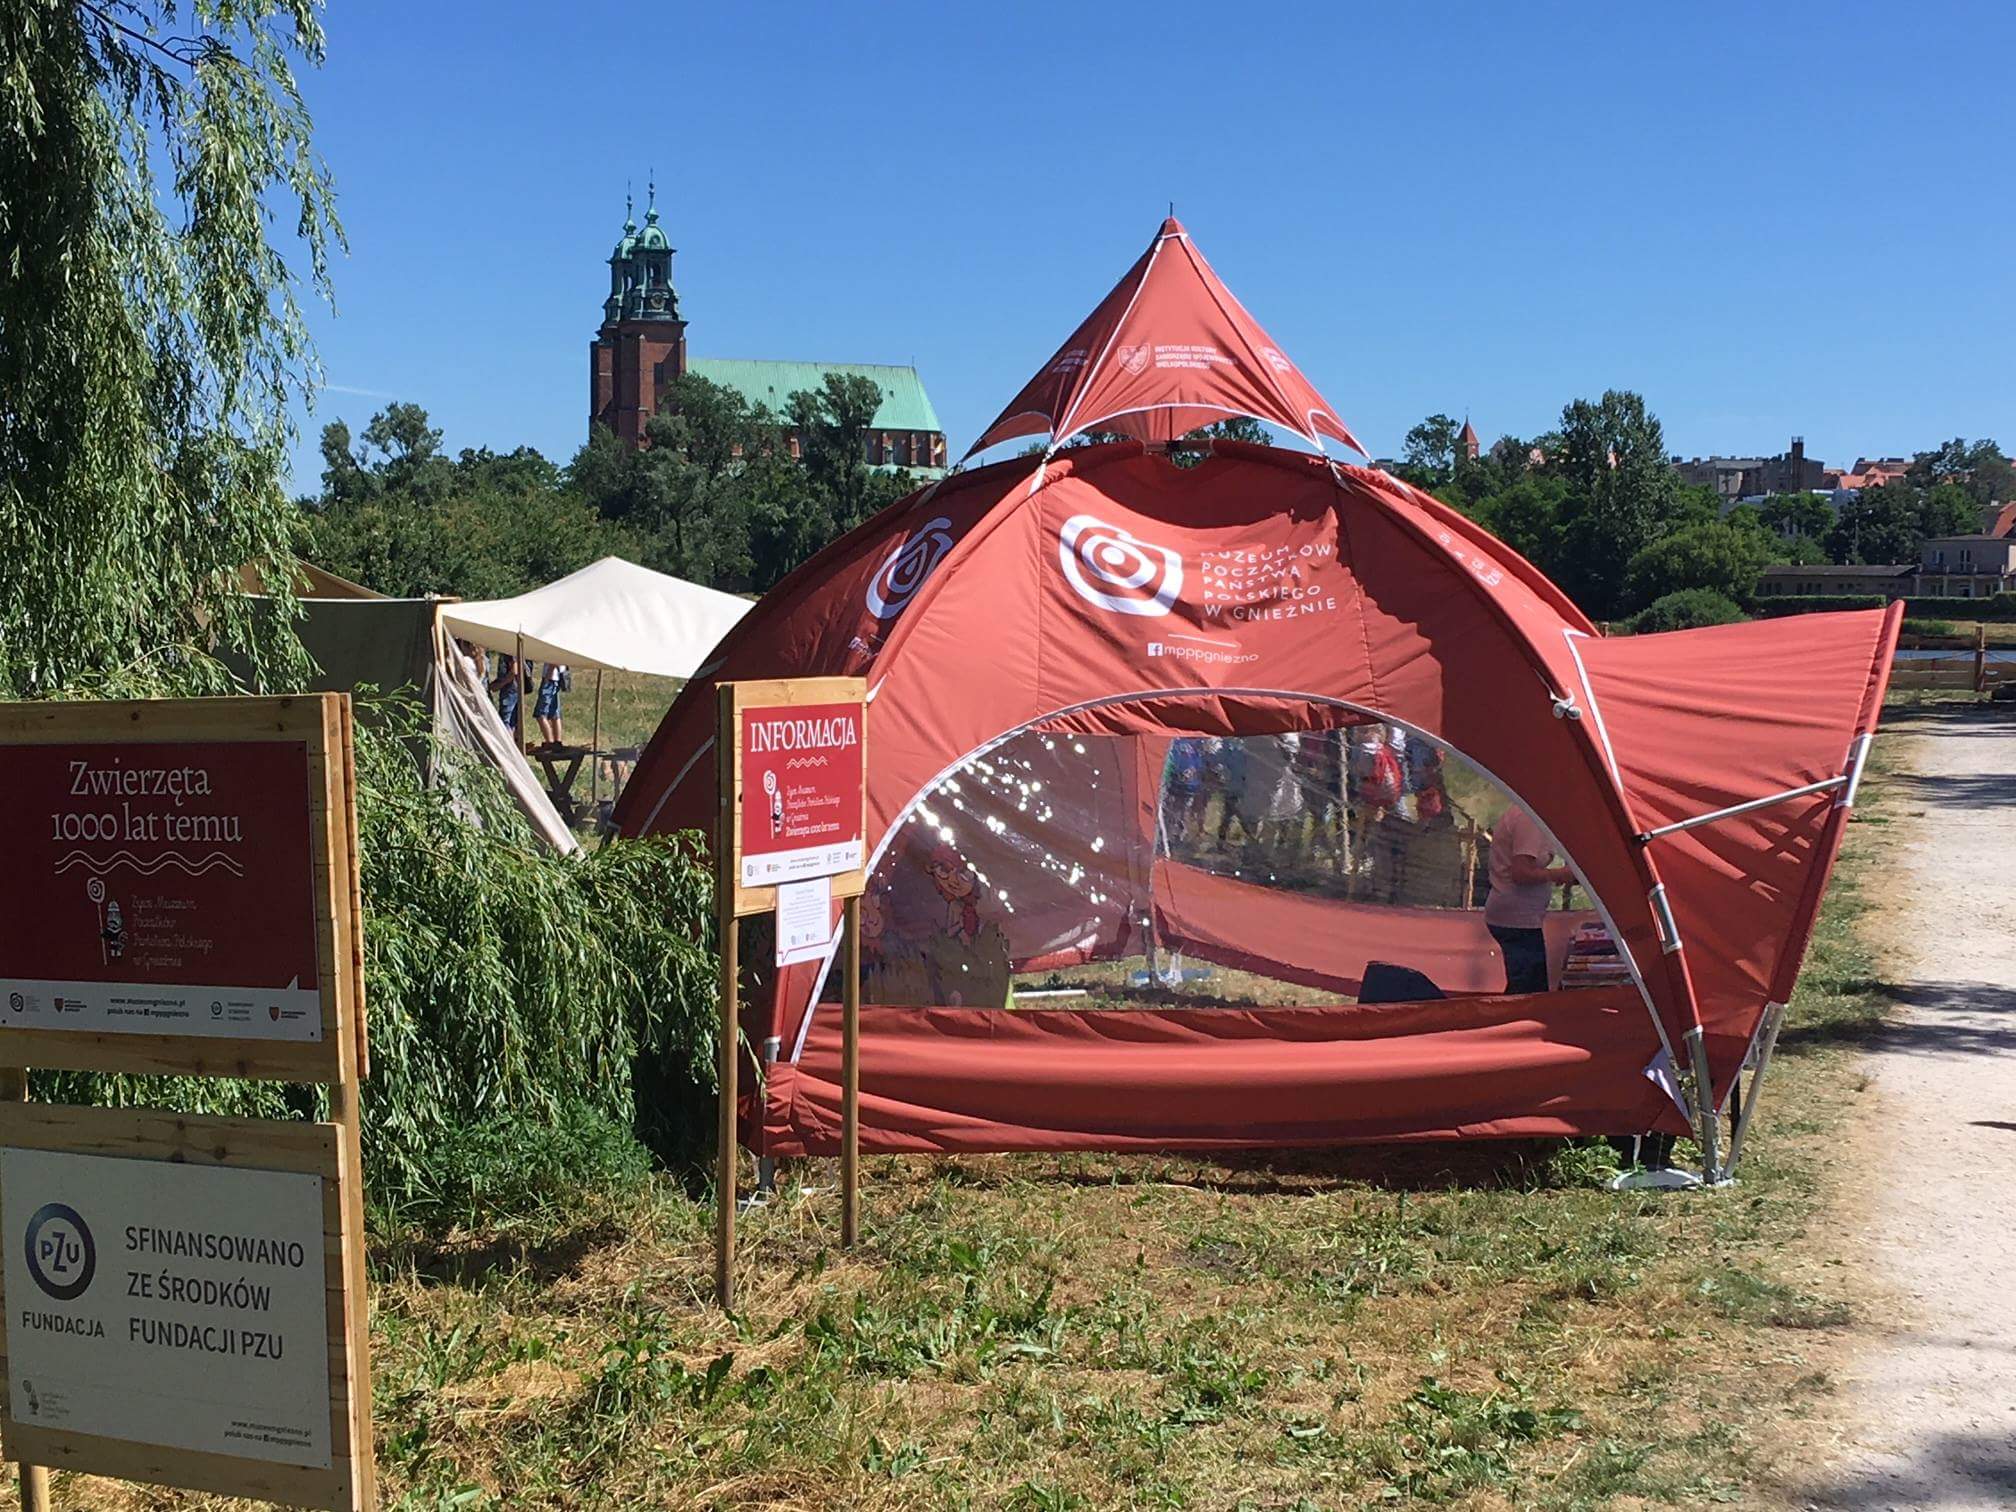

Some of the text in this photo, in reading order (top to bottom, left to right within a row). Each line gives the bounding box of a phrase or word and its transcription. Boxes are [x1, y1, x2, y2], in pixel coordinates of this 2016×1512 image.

[1204, 585, 1321, 600] POLSKIEGO
[1204, 603, 1222, 617] W
[1164, 645, 1259, 663] mpppgniezno
[750, 716, 857, 752] INFORMACJA
[69, 757, 212, 806] Zwierzęta
[51, 803, 243, 842] 1000 lat temu
[41, 1231, 80, 1273] PZU
[125, 1226, 305, 1269] SFINANSOWANO
[127, 1268, 271, 1312] ZE ŚRODKÓW
[22, 1311, 105, 1339] FUNDACJA
[129, 1317, 283, 1361] FUNDACJI PZU
